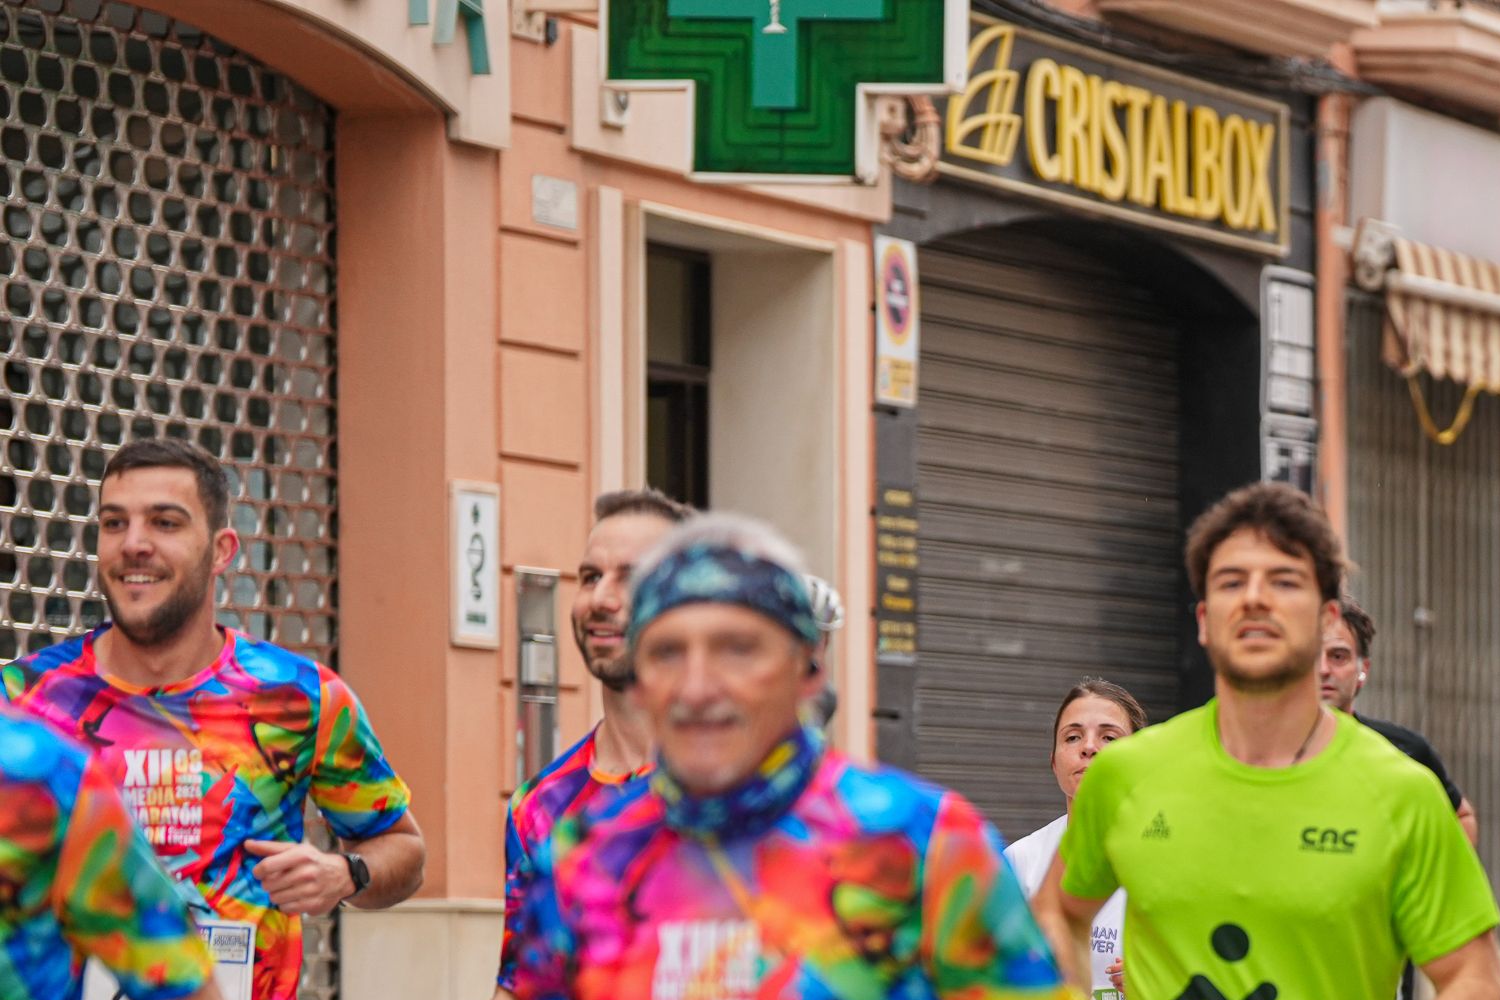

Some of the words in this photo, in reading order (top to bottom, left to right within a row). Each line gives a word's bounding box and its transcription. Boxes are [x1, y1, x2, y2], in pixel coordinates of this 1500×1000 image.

[1024, 58, 1277, 233] CRISTALBOX
[123, 749, 173, 786] XII
[123, 787, 175, 806] MEDIA
